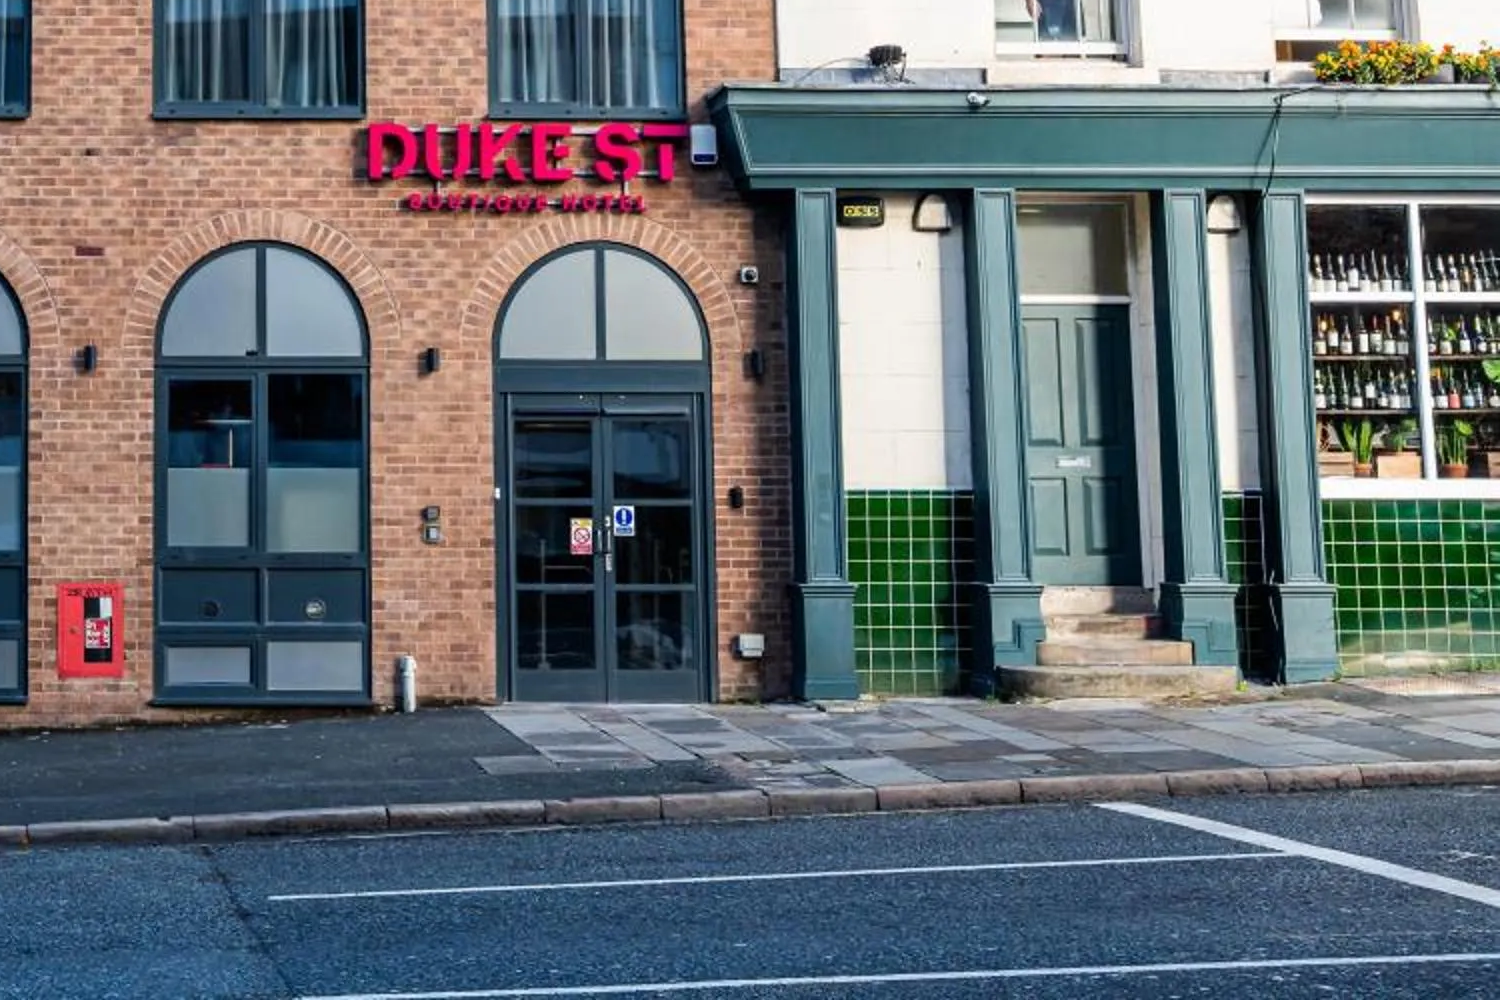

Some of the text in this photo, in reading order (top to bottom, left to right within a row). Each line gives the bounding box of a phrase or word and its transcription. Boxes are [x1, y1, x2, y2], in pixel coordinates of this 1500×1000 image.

[368, 123, 687, 181] DUKE ST
[407, 191, 646, 214] BOUTIQUE HOTEL
